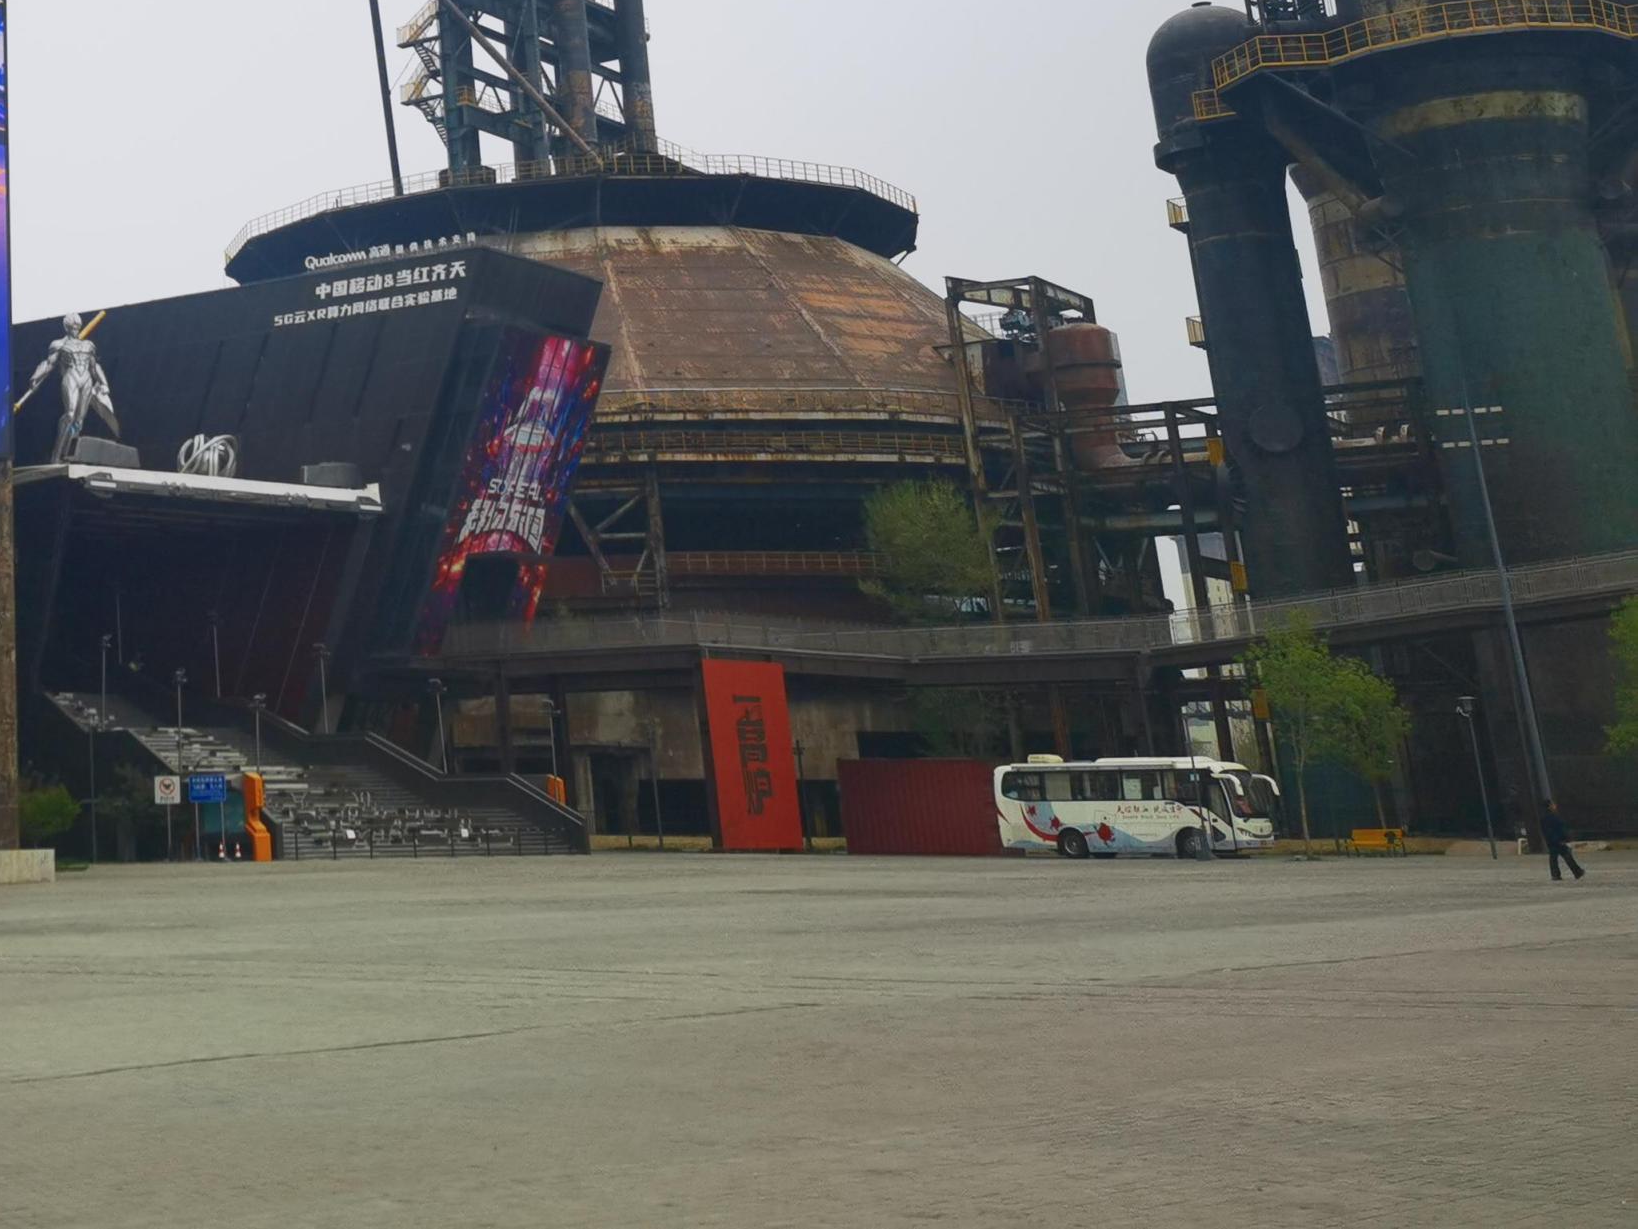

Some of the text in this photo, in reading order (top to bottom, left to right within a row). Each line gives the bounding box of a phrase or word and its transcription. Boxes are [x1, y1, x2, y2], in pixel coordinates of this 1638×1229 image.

[304, 250, 367, 271] Qualcomm
[315, 261, 467, 300] 中国移动&当红齐天
